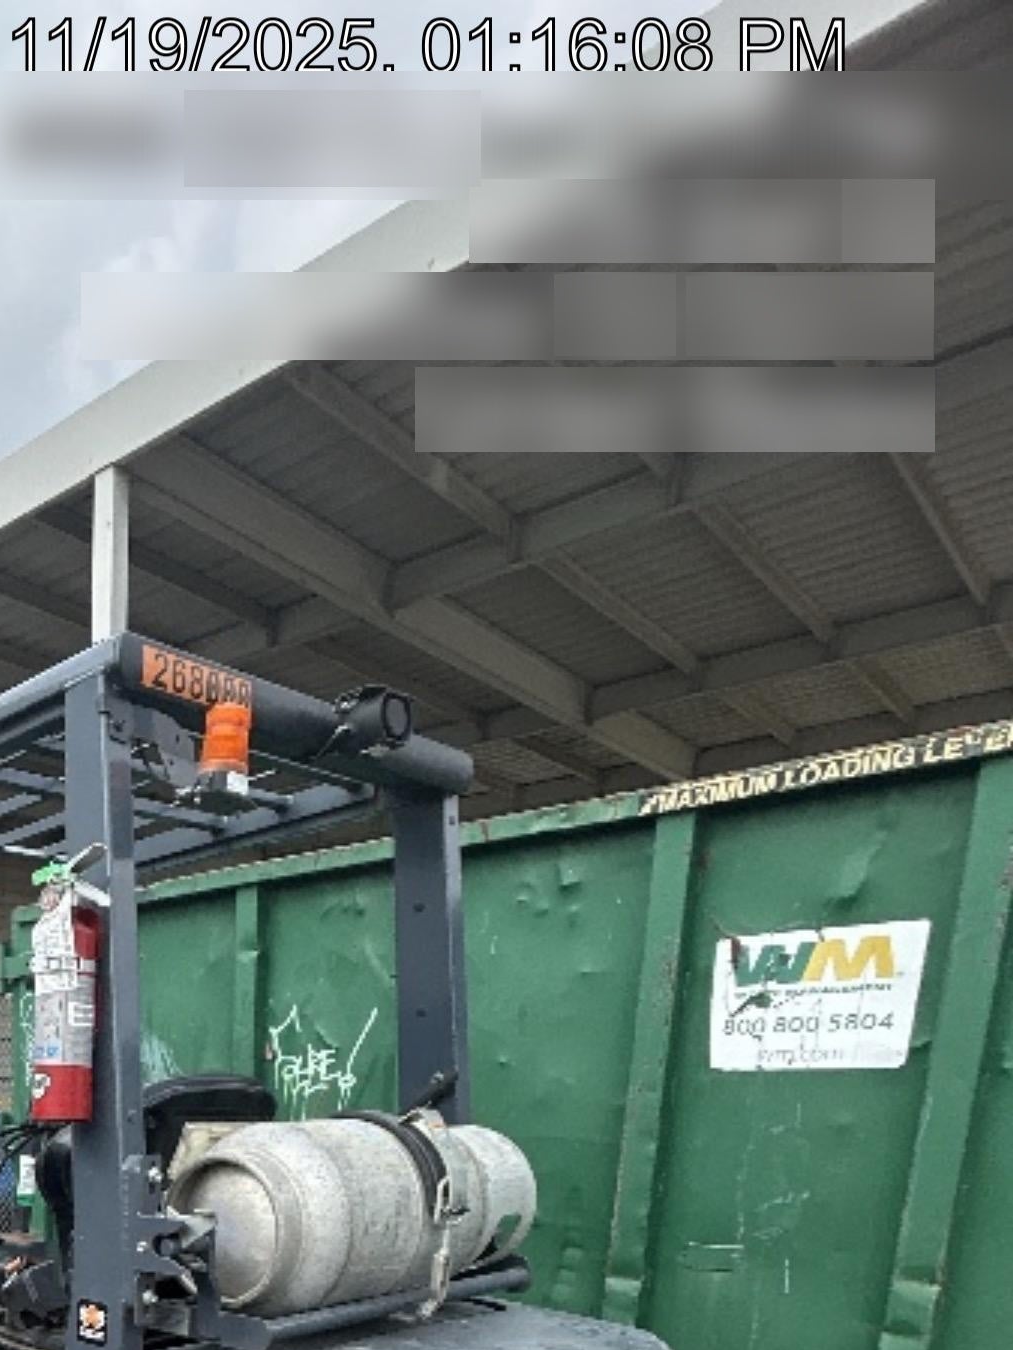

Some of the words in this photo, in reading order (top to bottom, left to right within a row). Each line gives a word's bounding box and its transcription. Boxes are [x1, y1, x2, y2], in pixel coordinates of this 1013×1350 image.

[658, 768, 778, 814] MAXIMUM
[784, 742, 916, 790] LOADING
[732, 935, 896, 988] WM
[772, 1014, 821, 1033] 800
[827, 1011, 895, 1033] 5804
